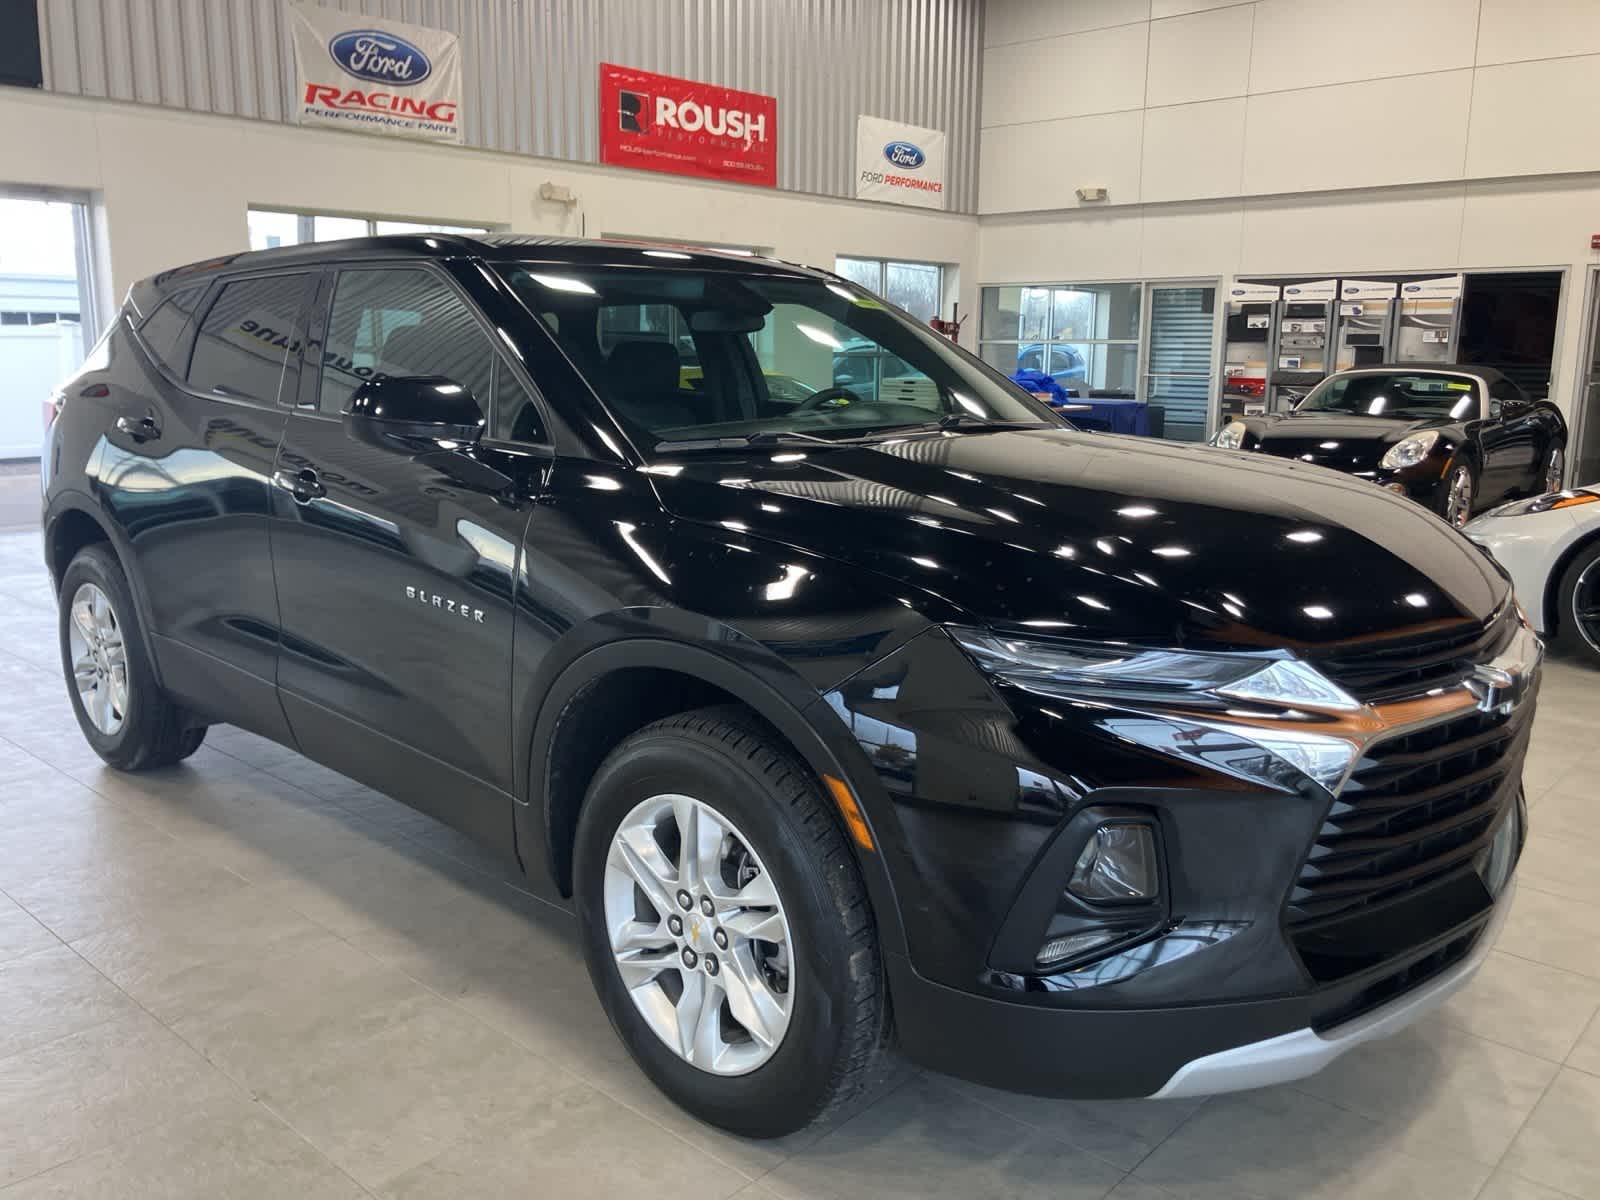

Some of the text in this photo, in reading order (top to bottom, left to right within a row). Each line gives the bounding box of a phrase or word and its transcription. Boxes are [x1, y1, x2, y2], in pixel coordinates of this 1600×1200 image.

[350, 37, 412, 79] Ford
[304, 84, 457, 122] RACING
[305, 107, 457, 134] PERFORMANCE PARTS
[655, 96, 766, 142] ROUSH
[891, 144, 917, 165] Ford
[861, 171, 943, 193] FORD PERFORMANCE
[406, 586, 484, 623] BLAZER
